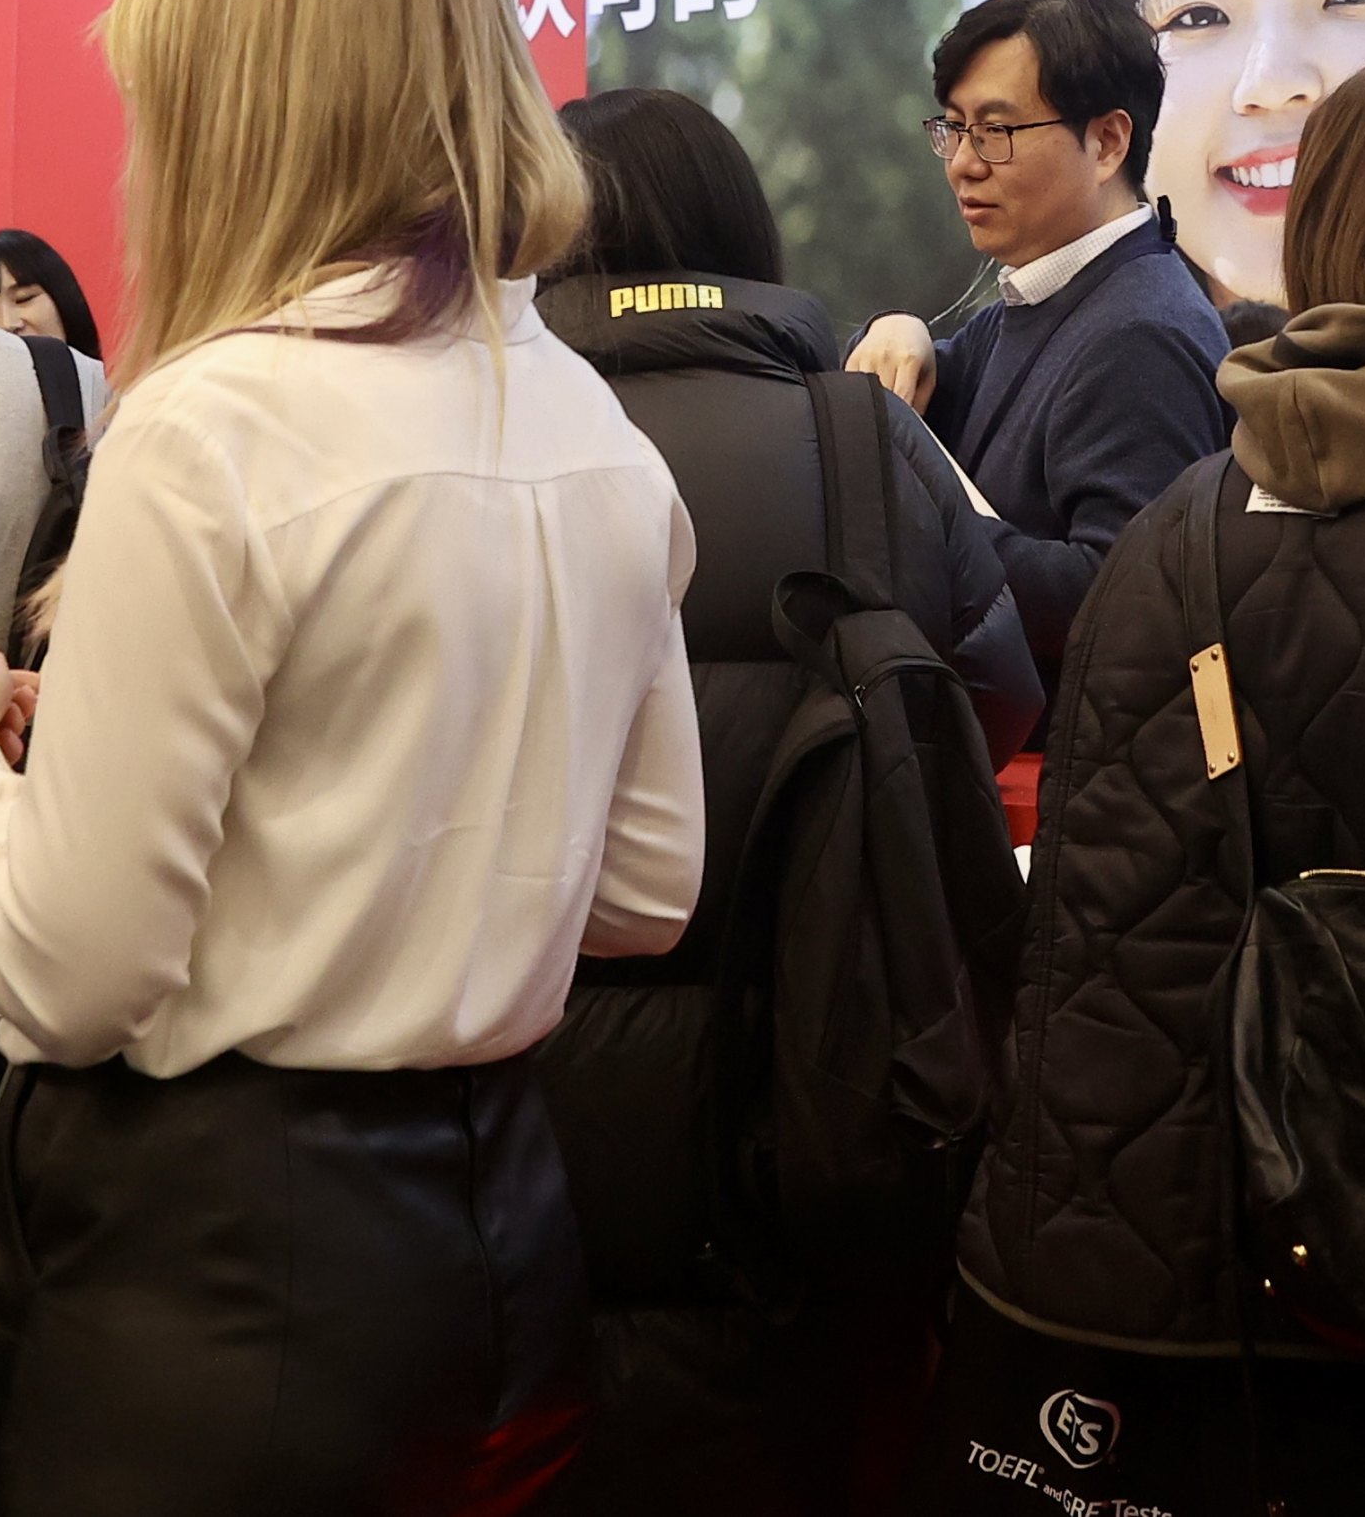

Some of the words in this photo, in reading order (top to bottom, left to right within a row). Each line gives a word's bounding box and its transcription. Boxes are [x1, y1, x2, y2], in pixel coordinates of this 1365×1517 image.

[609, 283, 724, 318] PUMA
[1056, 1398, 1102, 1455] ETS
[1043, 1483, 1063, 1502] and
